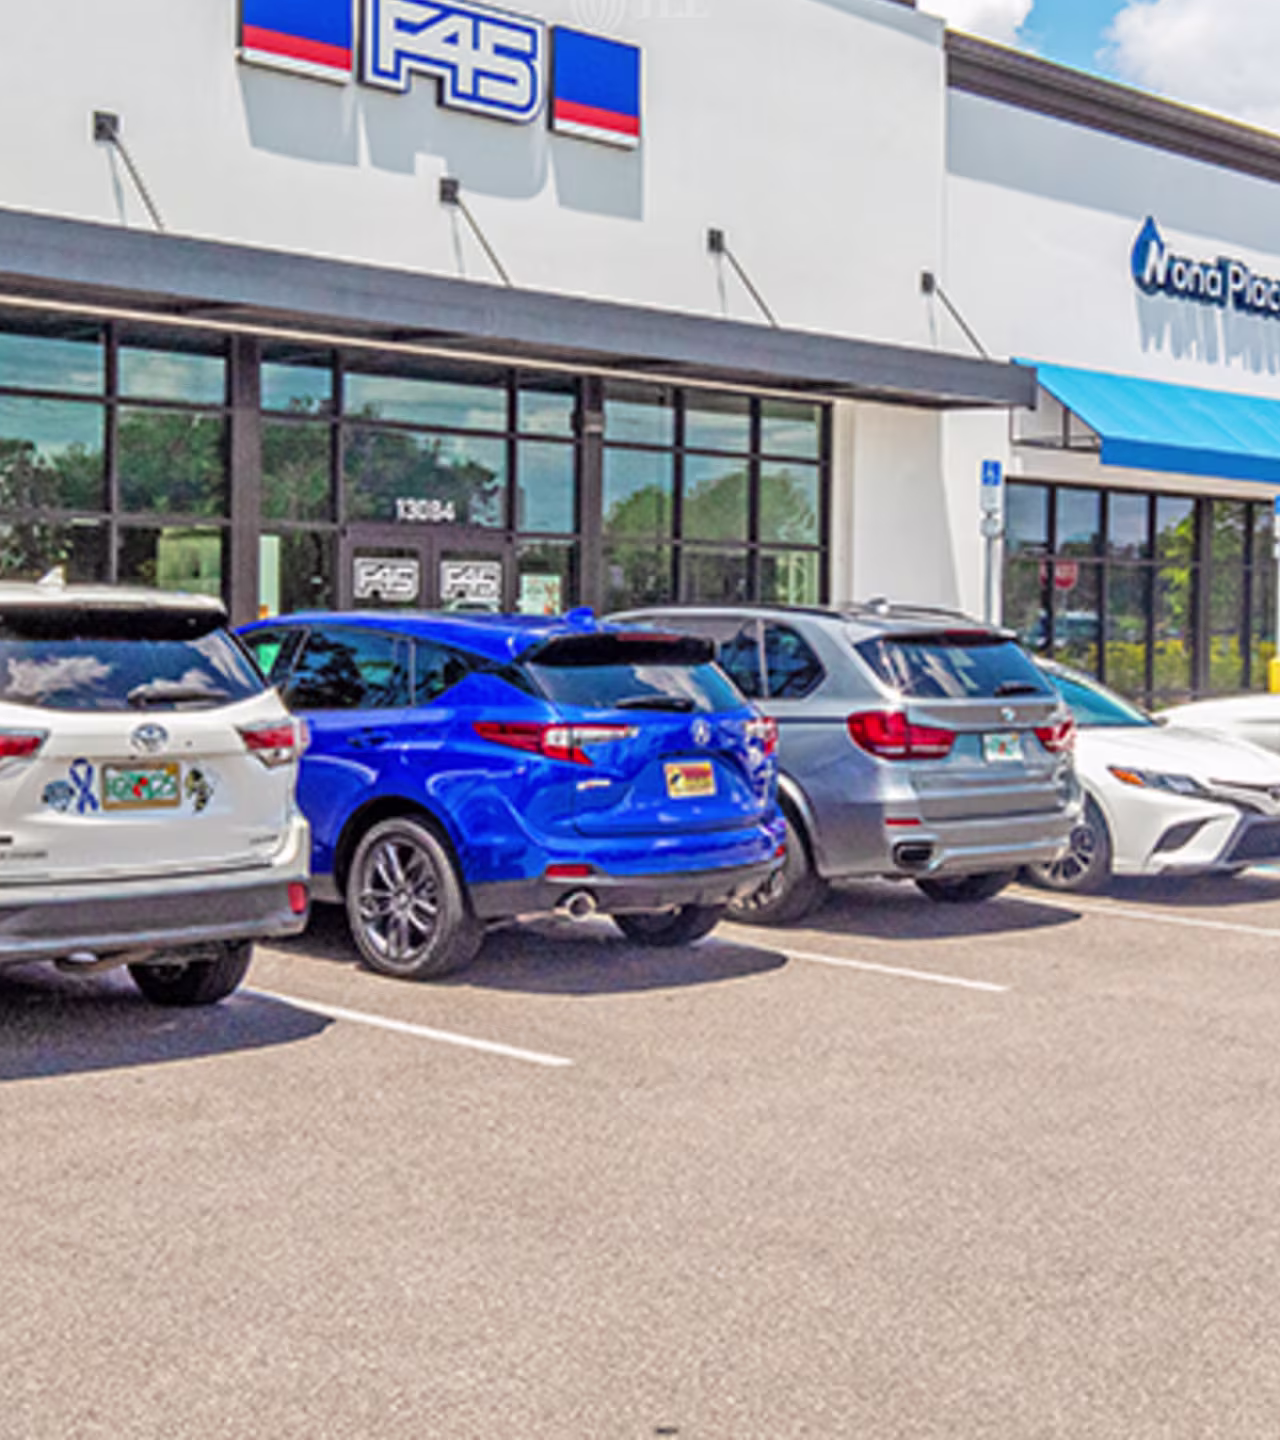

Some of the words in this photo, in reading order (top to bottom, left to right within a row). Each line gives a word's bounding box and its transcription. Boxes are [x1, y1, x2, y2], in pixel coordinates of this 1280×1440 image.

[1144, 238, 1223, 303] Nona
[358, 564, 415, 596] F45
[442, 565, 499, 596] F45
